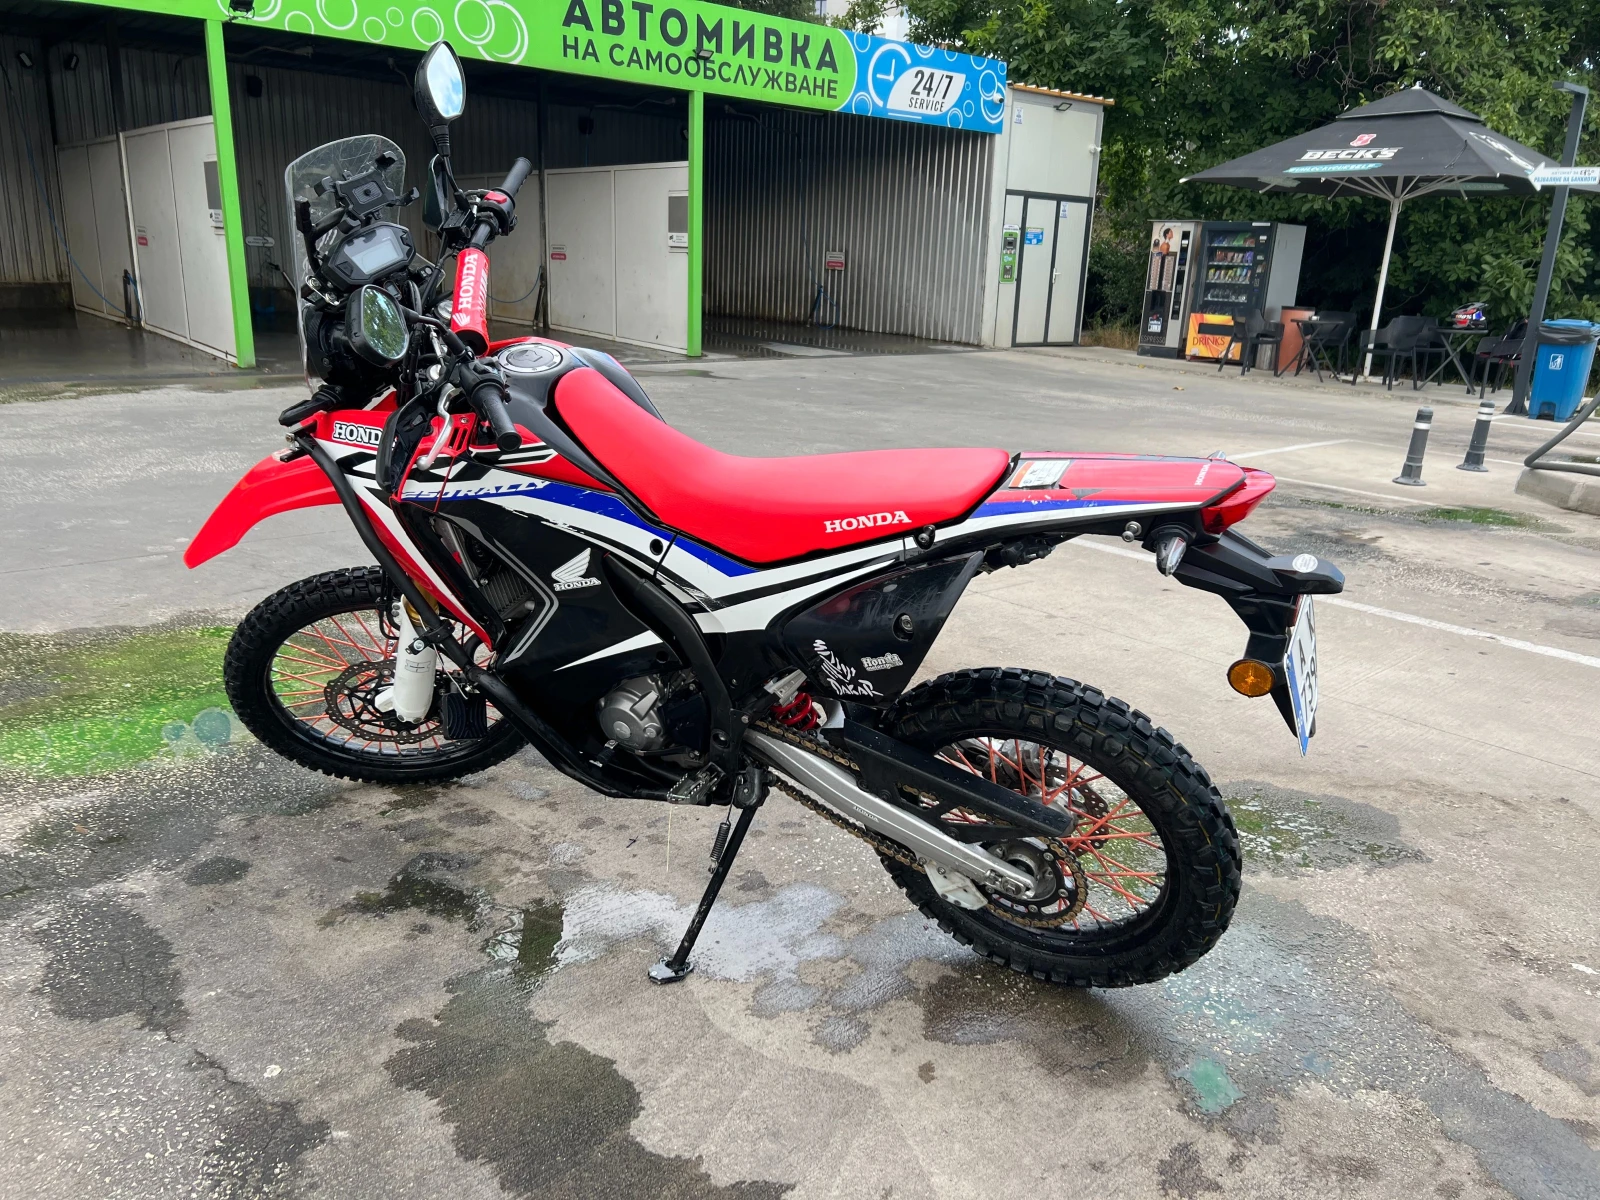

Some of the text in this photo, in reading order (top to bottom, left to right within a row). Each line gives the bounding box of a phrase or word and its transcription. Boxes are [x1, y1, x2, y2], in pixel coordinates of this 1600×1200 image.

[562, 0, 839, 74] АВТОМИВКА
[562, 34, 839, 100] НА САМООБСЛУЖВАНЕ
[910, 69, 954, 100] 24/7
[908, 96, 945, 112] SERVICE
[1299, 146, 1400, 160] BECK'S
[458, 253, 479, 311] HONDA
[1192, 336, 1225, 345] DRINKS
[333, 423, 397, 450] HOND
[1193, 463, 1212, 486] HONDA
[823, 510, 912, 533] HONDA
[553, 577, 602, 592] HONDA
[827, 679, 884, 697] DAKAR
